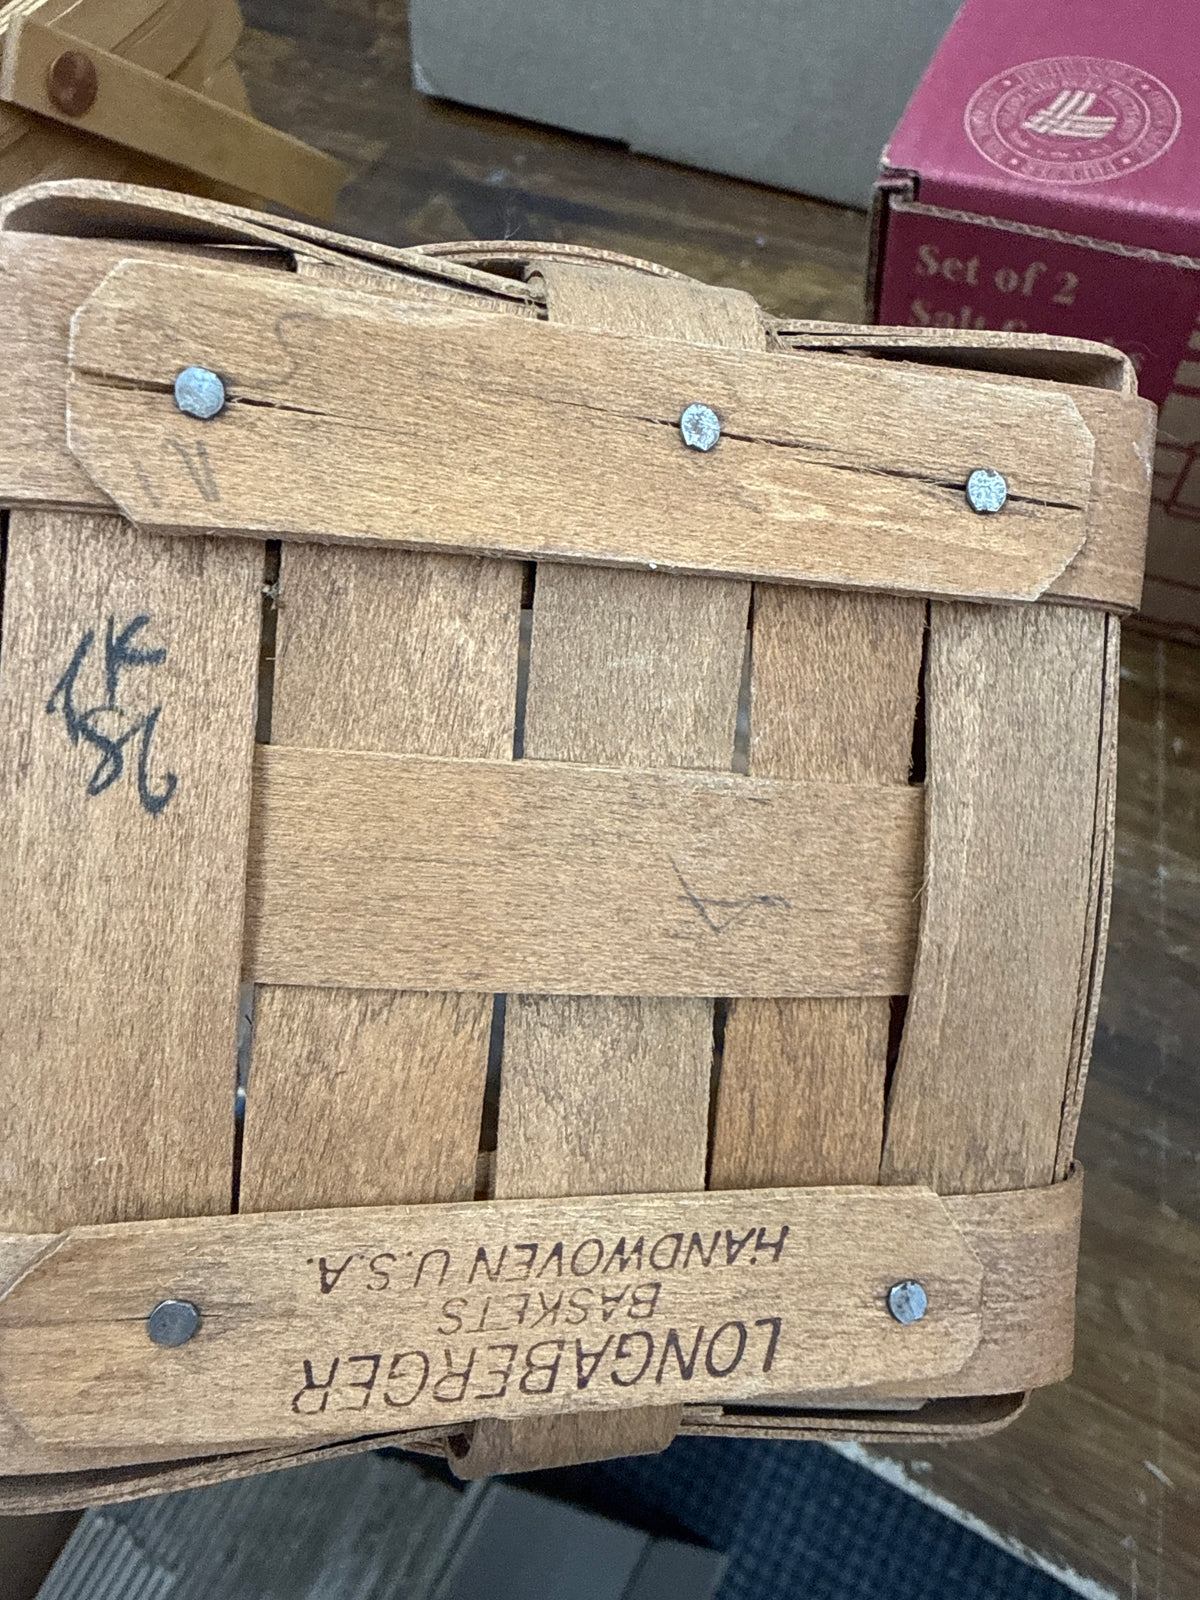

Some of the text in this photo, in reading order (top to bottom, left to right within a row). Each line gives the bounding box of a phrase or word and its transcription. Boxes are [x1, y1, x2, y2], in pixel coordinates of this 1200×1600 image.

[914, 244, 1080, 306] Set of 2
[307, 1225, 790, 1295] HANDWOVEN U.S.A.
[437, 1281, 662, 1336] BASKETS
[291, 1317, 783, 1416] LONGABERGER
